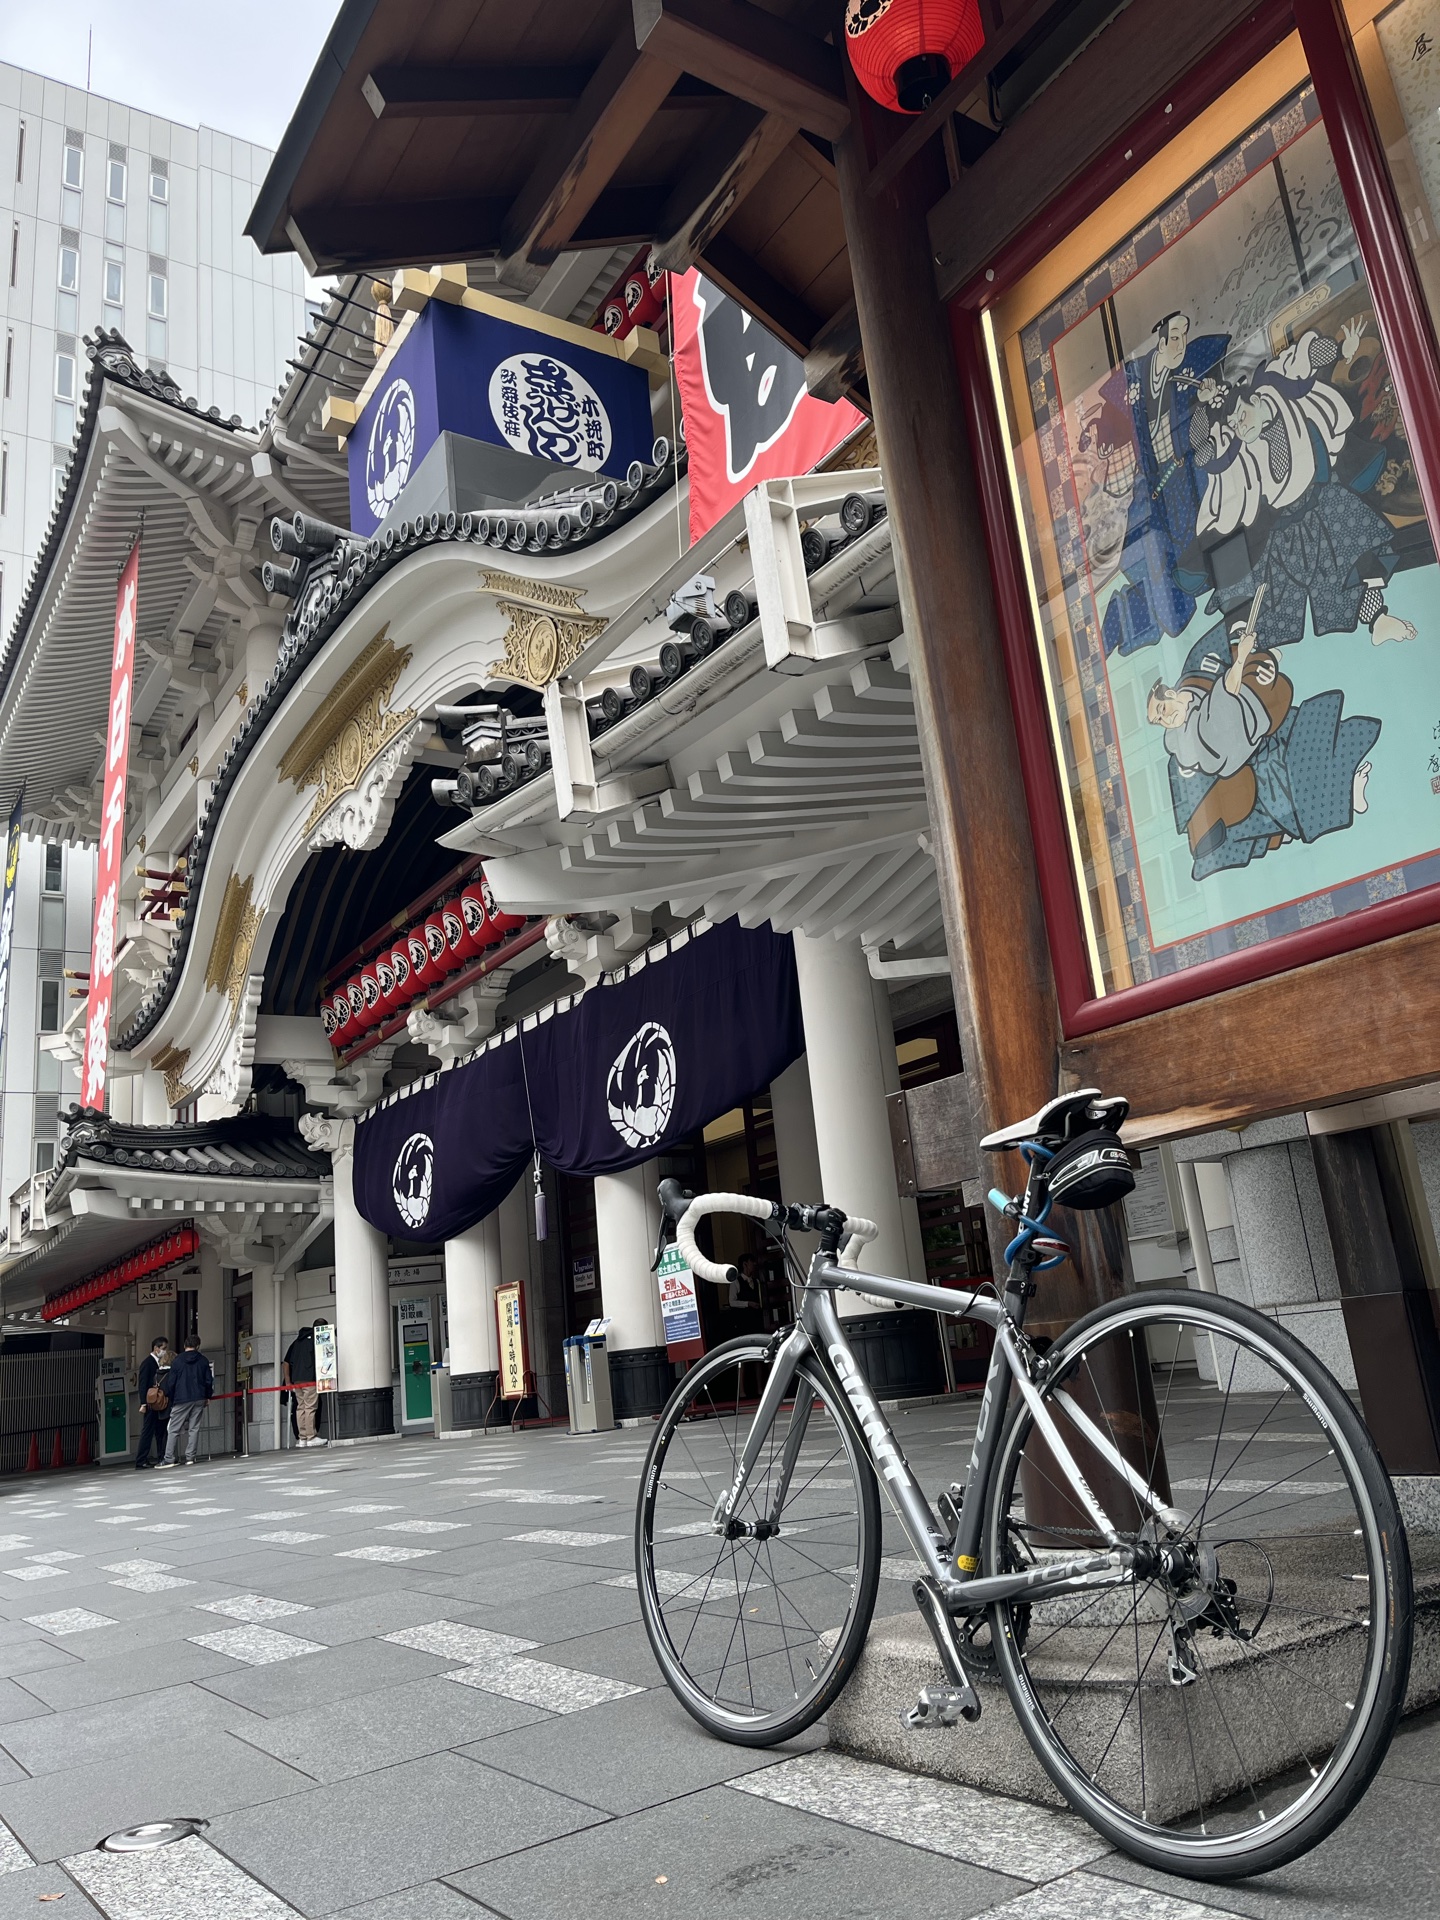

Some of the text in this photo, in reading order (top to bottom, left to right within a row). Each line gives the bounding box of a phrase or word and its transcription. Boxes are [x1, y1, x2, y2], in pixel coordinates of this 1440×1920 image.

[1411, 32, 1434, 62] 昼
[500, 368, 521, 438] 歌舞伎座
[580, 394, 606, 461] 木挽町
[828, 1343, 912, 1487] GIANT
[1302, 1392, 1329, 1429] SHIMANO
[646, 1464, 658, 1499] SHIMANO
[725, 1461, 746, 1515] GIANT
[1025, 1557, 1093, 1585] TCR
[1018, 1673, 1036, 1711] SHIMANO
